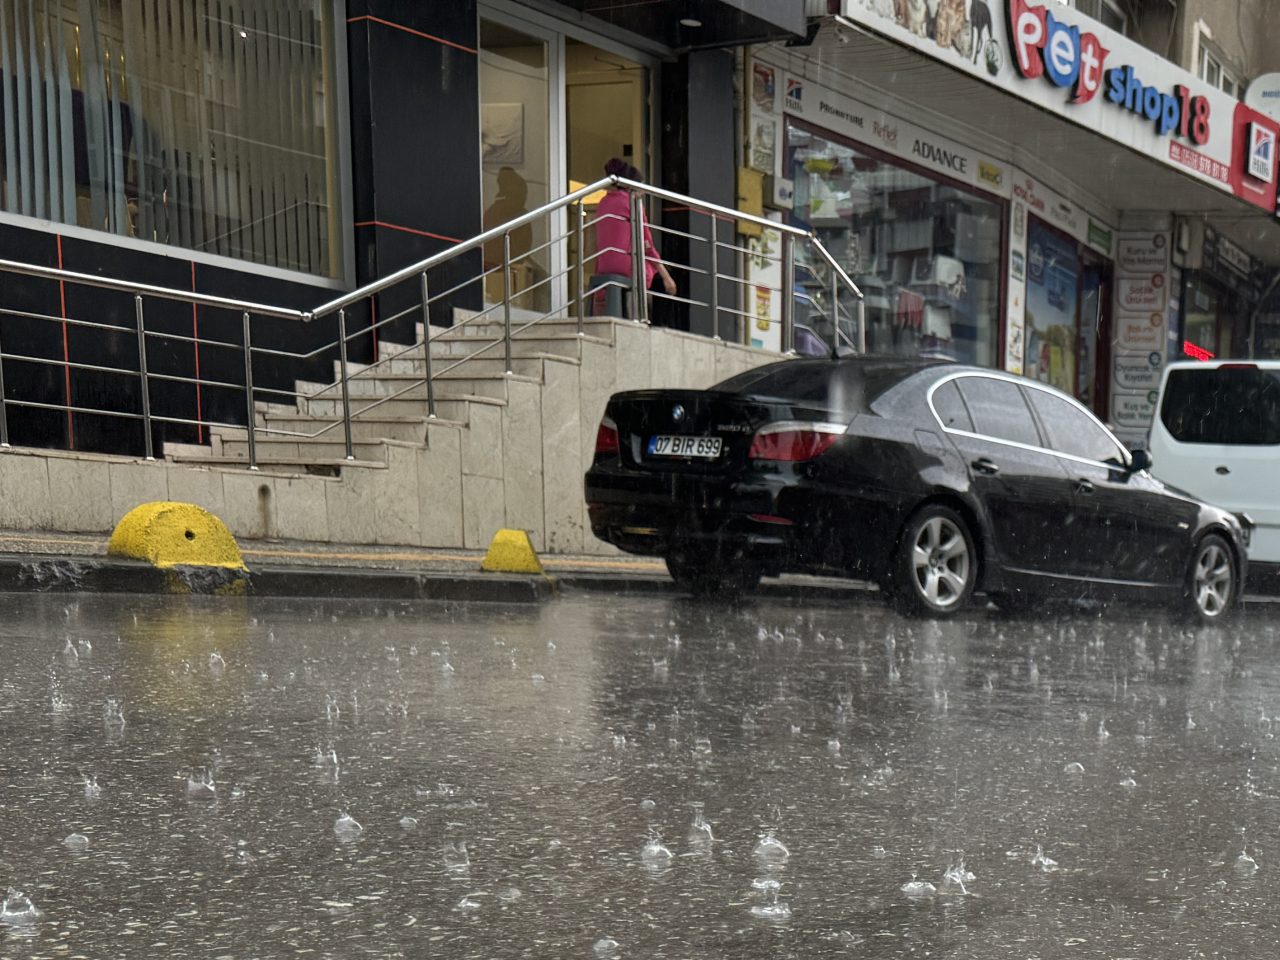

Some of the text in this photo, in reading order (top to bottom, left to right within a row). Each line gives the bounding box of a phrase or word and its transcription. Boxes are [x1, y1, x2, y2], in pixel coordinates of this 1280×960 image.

[912, 139, 967, 174] ADVANCE
[655, 436, 721, 455] 07 BIR 699
